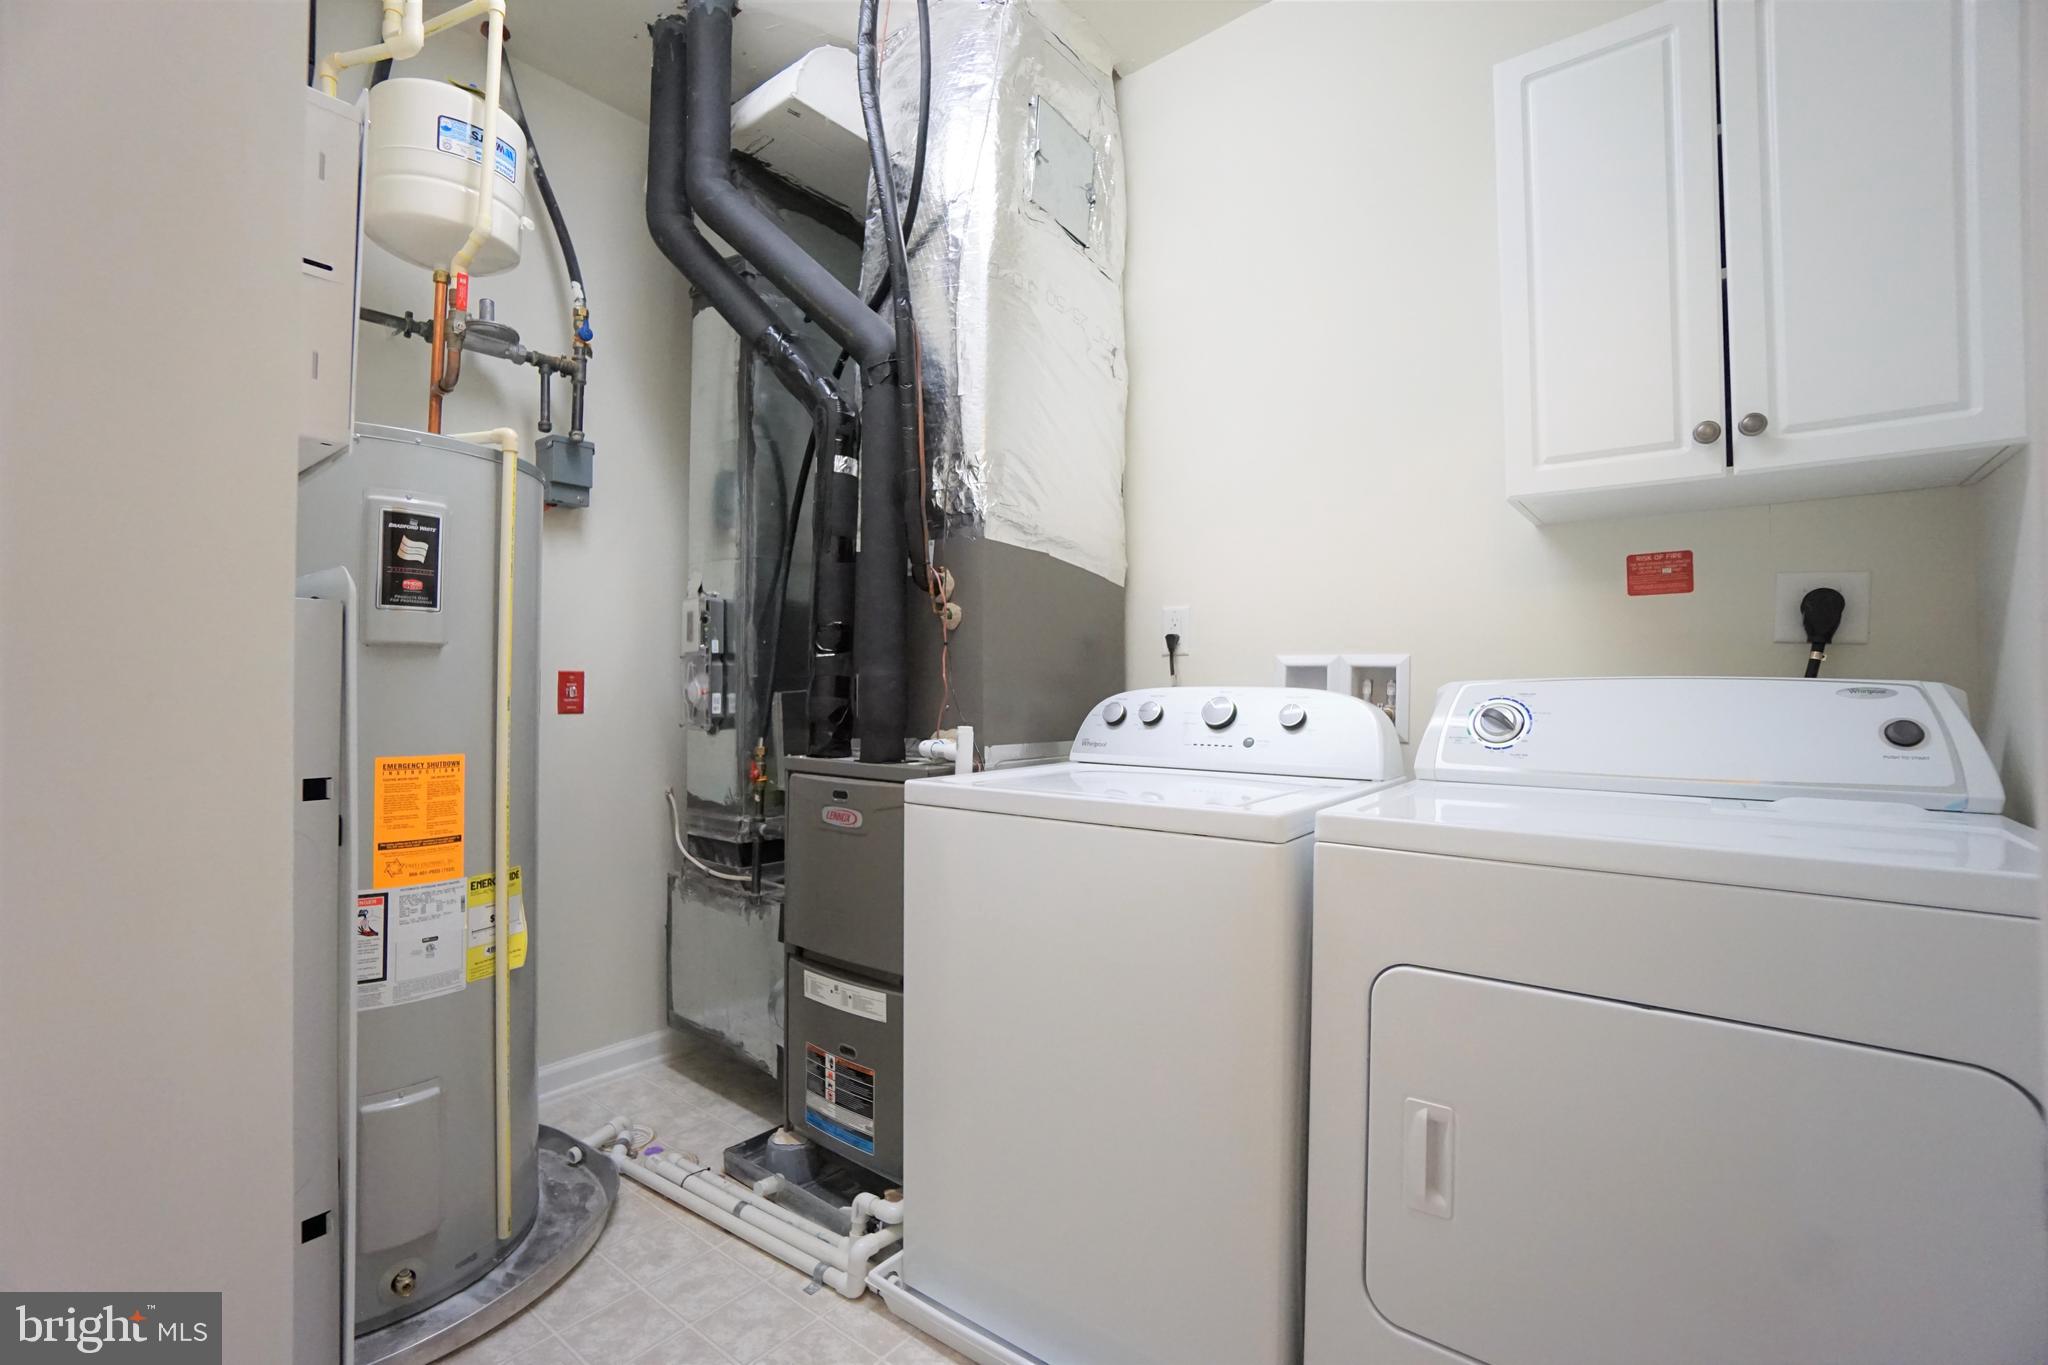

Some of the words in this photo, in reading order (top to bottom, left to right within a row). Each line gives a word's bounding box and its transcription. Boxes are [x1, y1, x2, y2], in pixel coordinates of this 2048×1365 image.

[388, 522, 419, 530] BRADFORD
[382, 762, 425, 771] EMERGENCY
[426, 760, 461, 769] SHUTDOWN
[826, 809, 853, 825] LENNOX
